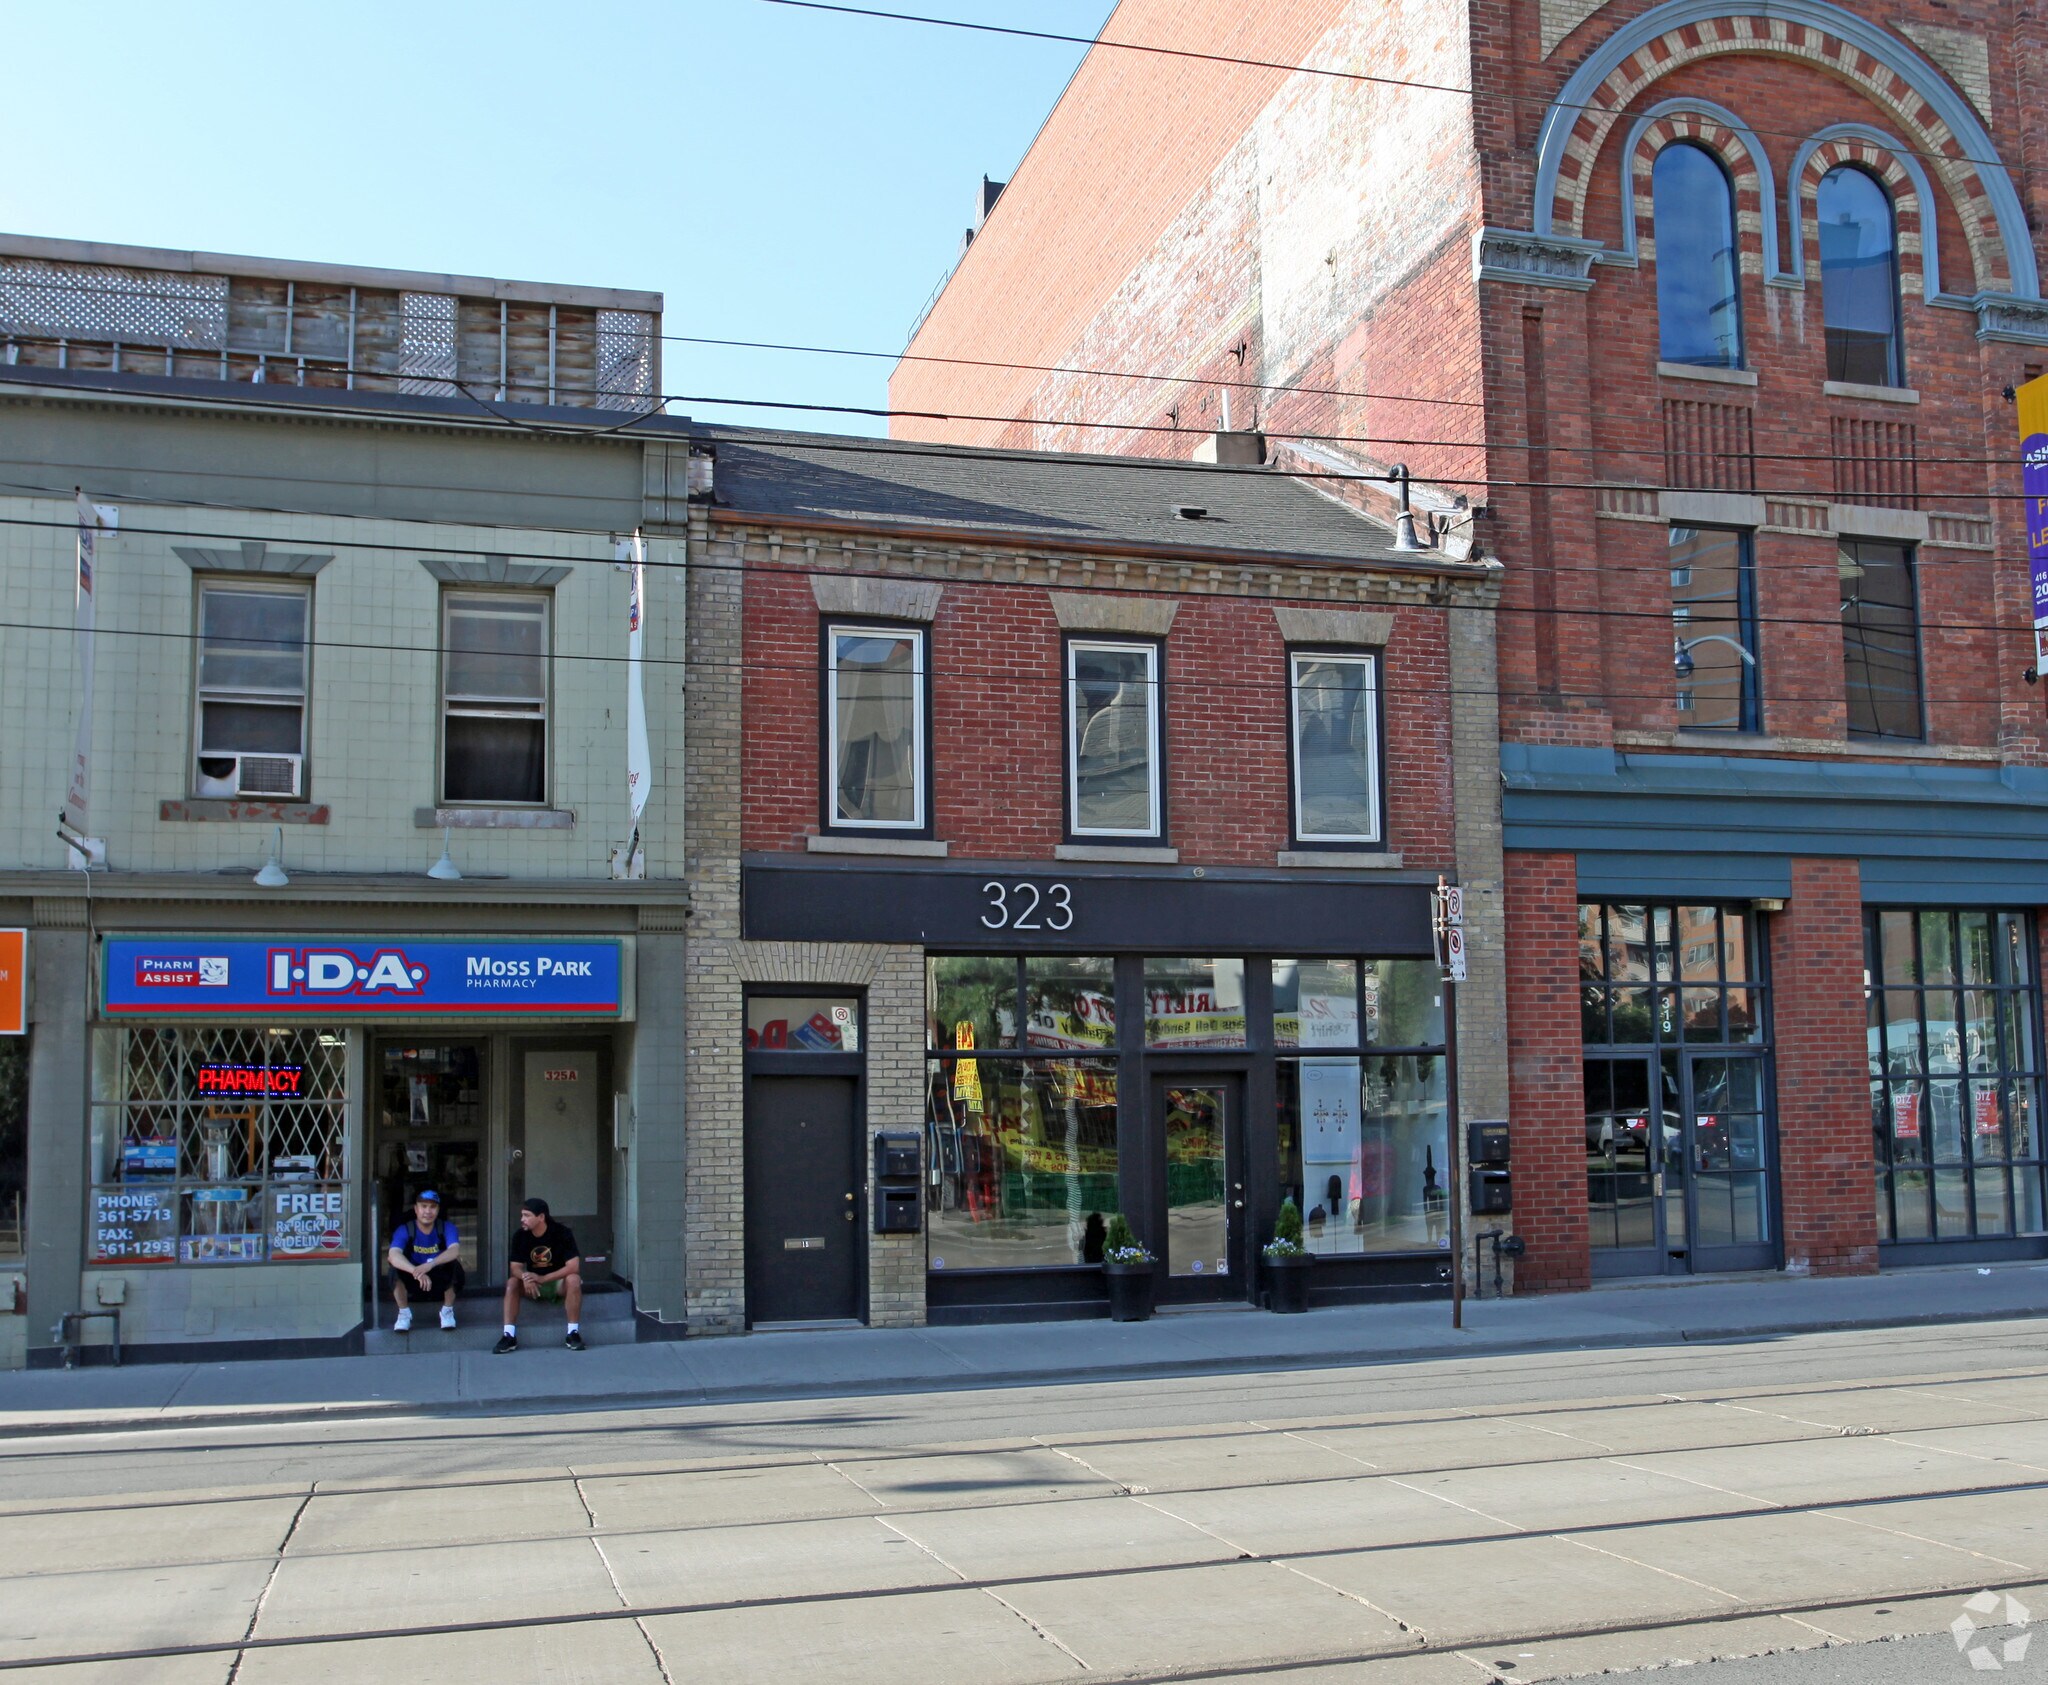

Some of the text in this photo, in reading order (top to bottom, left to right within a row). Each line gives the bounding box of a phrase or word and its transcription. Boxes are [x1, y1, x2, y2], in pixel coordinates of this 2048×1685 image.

[981, 882, 1073, 930] 323
[143, 959, 193, 970] PHARM
[466, 956, 592, 976] MOSS PARK
[143, 972, 193, 983] ASSIST
[466, 978, 538, 988] PHARMACY
[1661, 997, 1672, 1033] 319
[199, 1069, 301, 1092] PHARMACY
[546, 1071, 577, 1081] 325A
[1895, 1095, 1912, 1104] DTZ
[98, 1195, 158, 1208] PHONE:
[276, 1193, 341, 1213] FREE
[98, 1209, 171, 1223] 361-5713
[294, 1220, 321, 1232] PICK
[324, 1220, 340, 1231] UP
[98, 1228, 133, 1241] FAX:
[286, 1235, 321, 1248] DELIV
